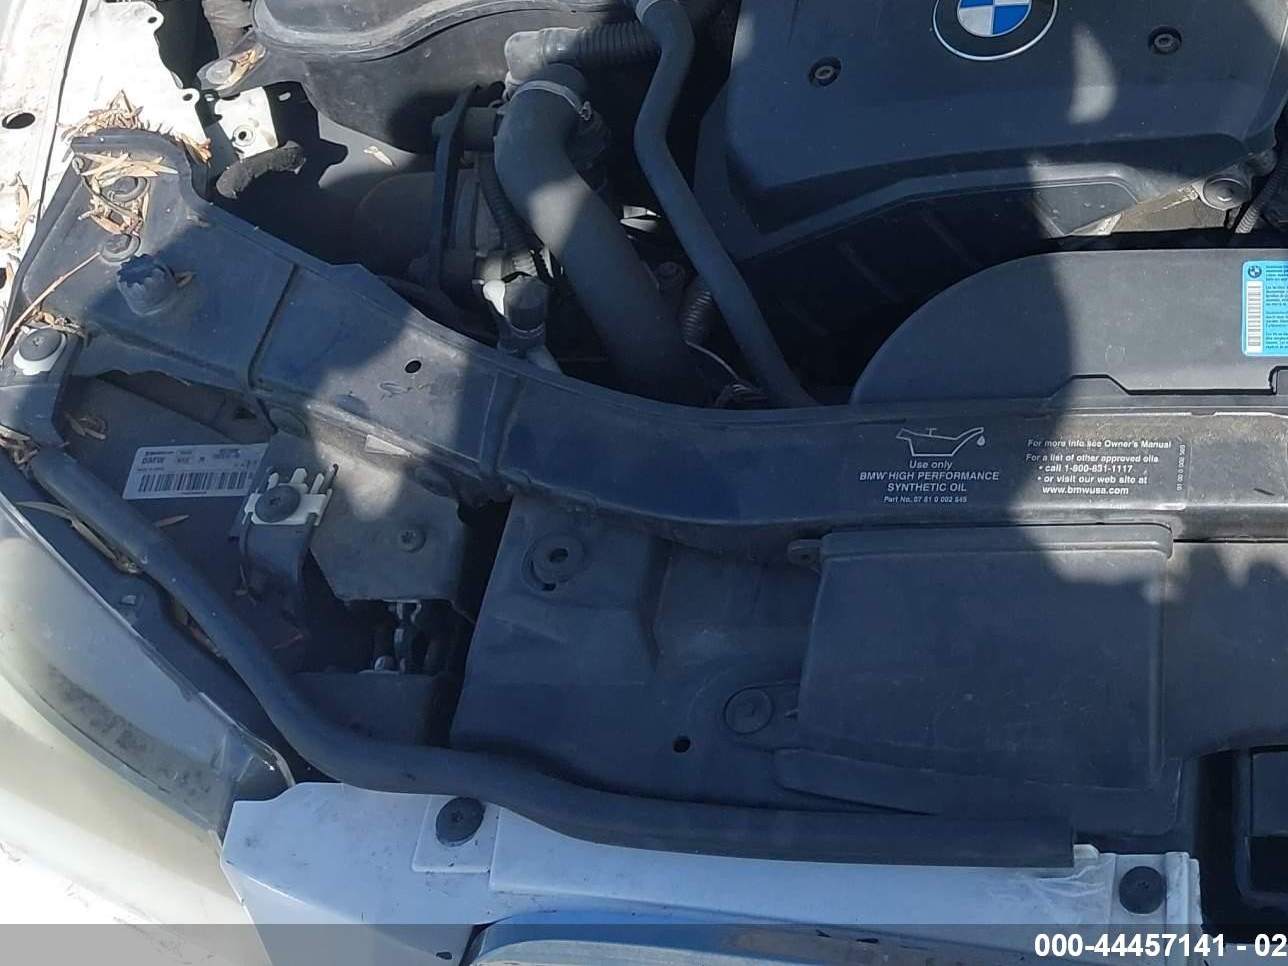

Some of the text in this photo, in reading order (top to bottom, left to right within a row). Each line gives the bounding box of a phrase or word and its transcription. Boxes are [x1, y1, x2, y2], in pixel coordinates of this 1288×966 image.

[1027, 438, 1172, 449] For more info see Owner's Manual
[1025, 453, 1159, 465] For a list of other approved oils
[909, 459, 953, 471] Use only
[1044, 464, 1133, 474] call 1-800-831-1117
[888, 471, 915, 481] HIGH
[917, 471, 1000, 481] PERFORMANCE
[1043, 474, 1148, 485] or visit our web site at
[887, 483, 967, 492] SYNTHETIC OIL
[1042, 486, 1129, 495] www.bmwusa.com
